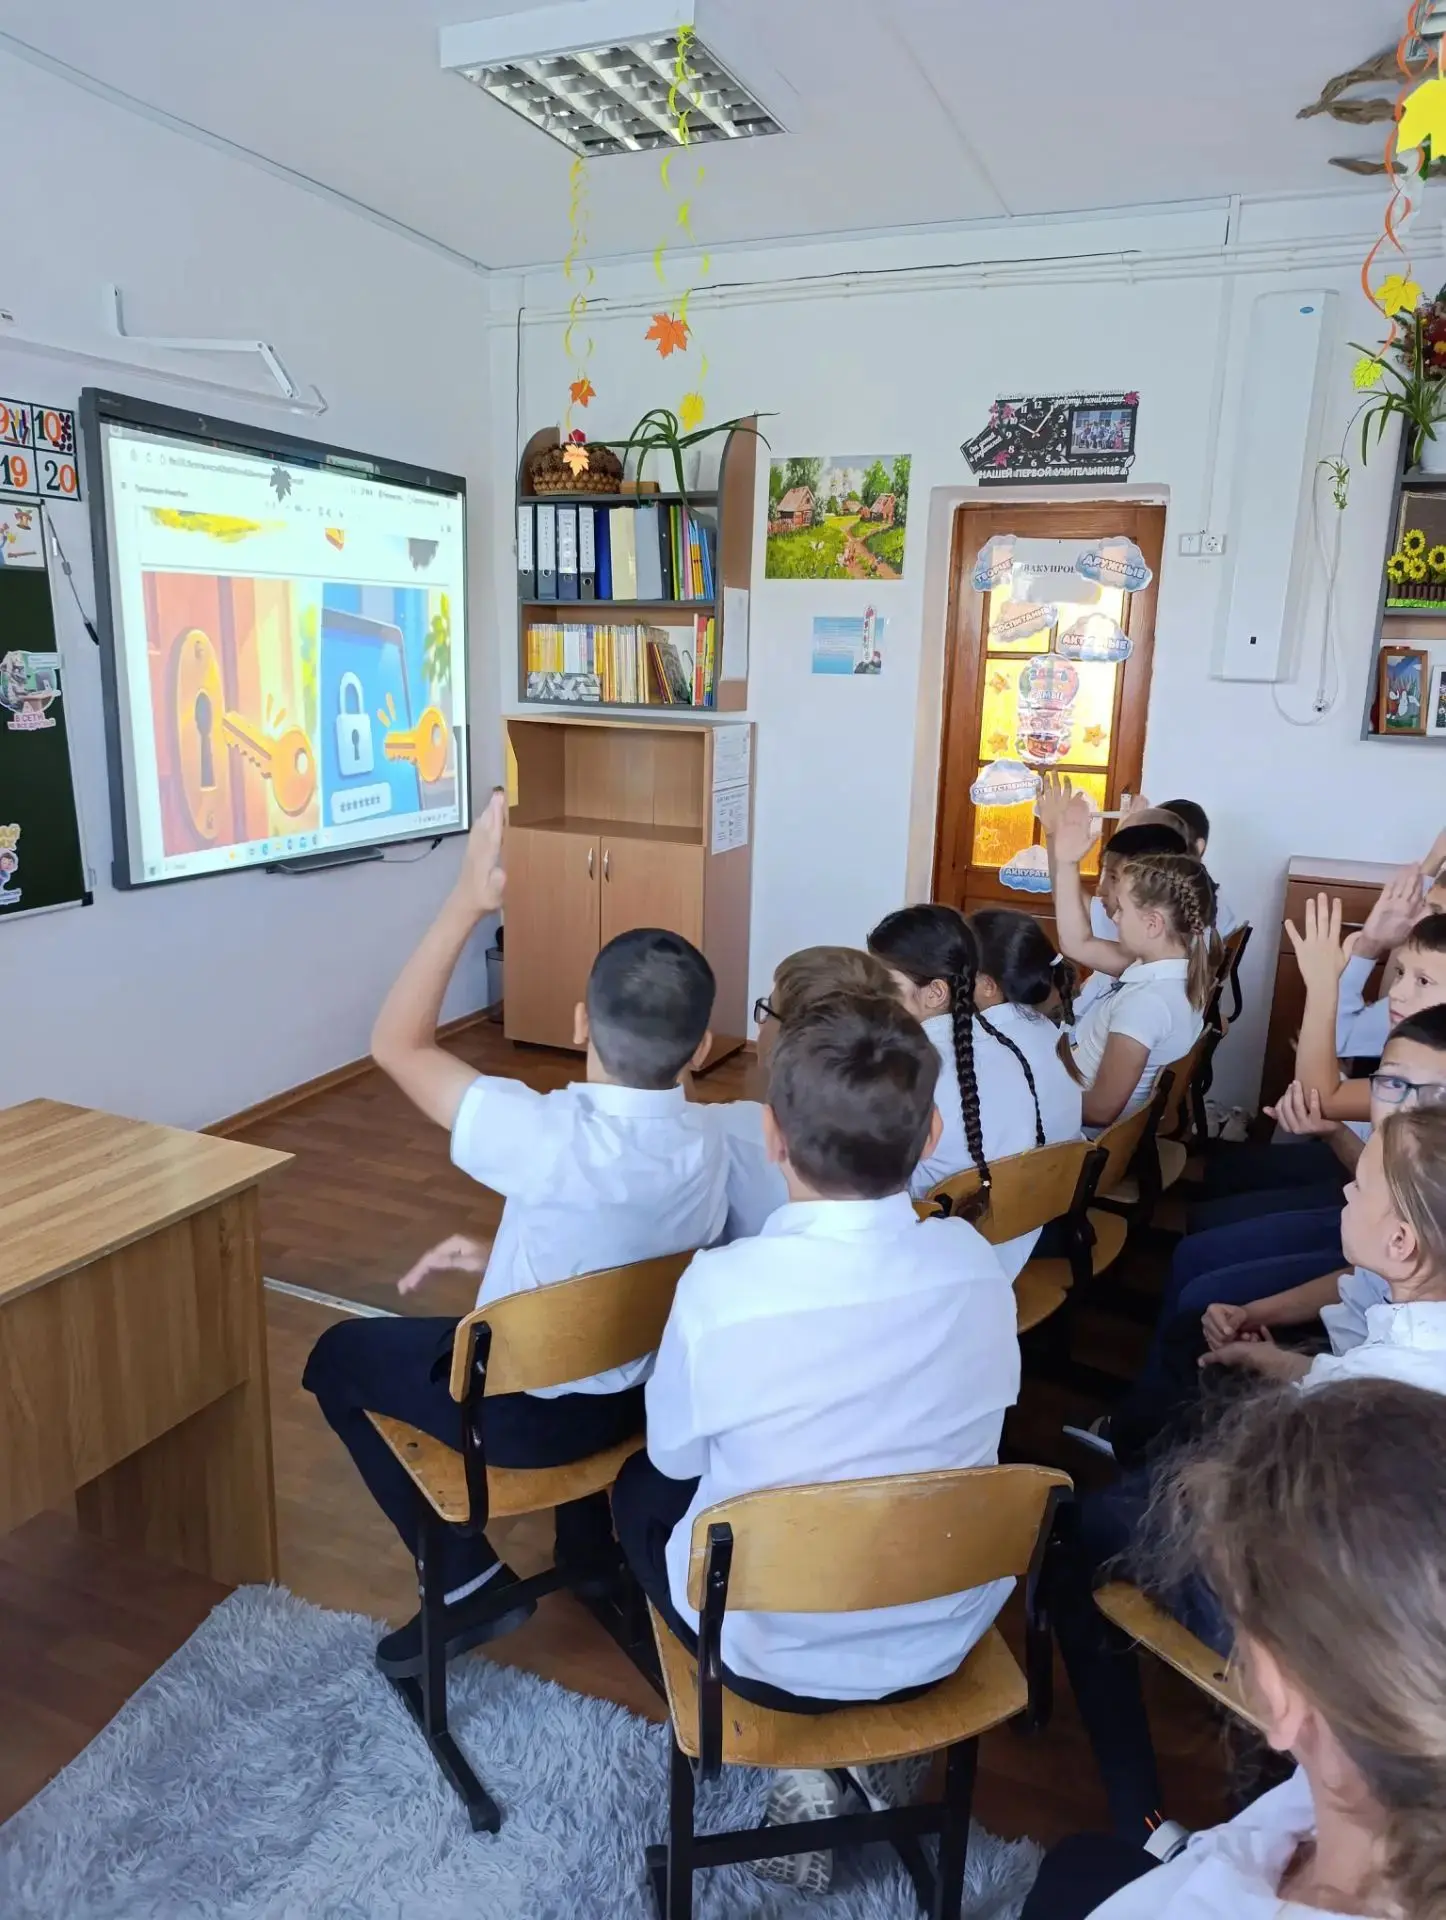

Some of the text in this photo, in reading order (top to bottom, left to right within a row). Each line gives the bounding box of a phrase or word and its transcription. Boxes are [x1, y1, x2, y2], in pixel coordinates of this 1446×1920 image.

[1034, 400, 1042, 409] 12
[1021, 406, 1028, 414] 11
[1010, 417, 1018, 425] 10
[1058, 415, 1065, 423] 2
[34, 410, 62, 442] 10
[1006, 431, 1012, 439] 9
[1060, 429, 1067, 438] 3
[1008, 445, 1015, 454] 8
[1056, 443, 1062, 452] 4
[1018, 456, 1024, 464] 7
[1031, 459, 1037, 467] 6
[1045, 455, 1051, 464] 5
[0, 454, 28, 488] 19
[979, 465, 1120, 479] НАШЕЙ ПЕРВОЙ УЧИТЕЛЬНИЦЕ
[44, 460, 76, 493] 20
[1082, 552, 1146, 579] ДРУЖНЫЕ
